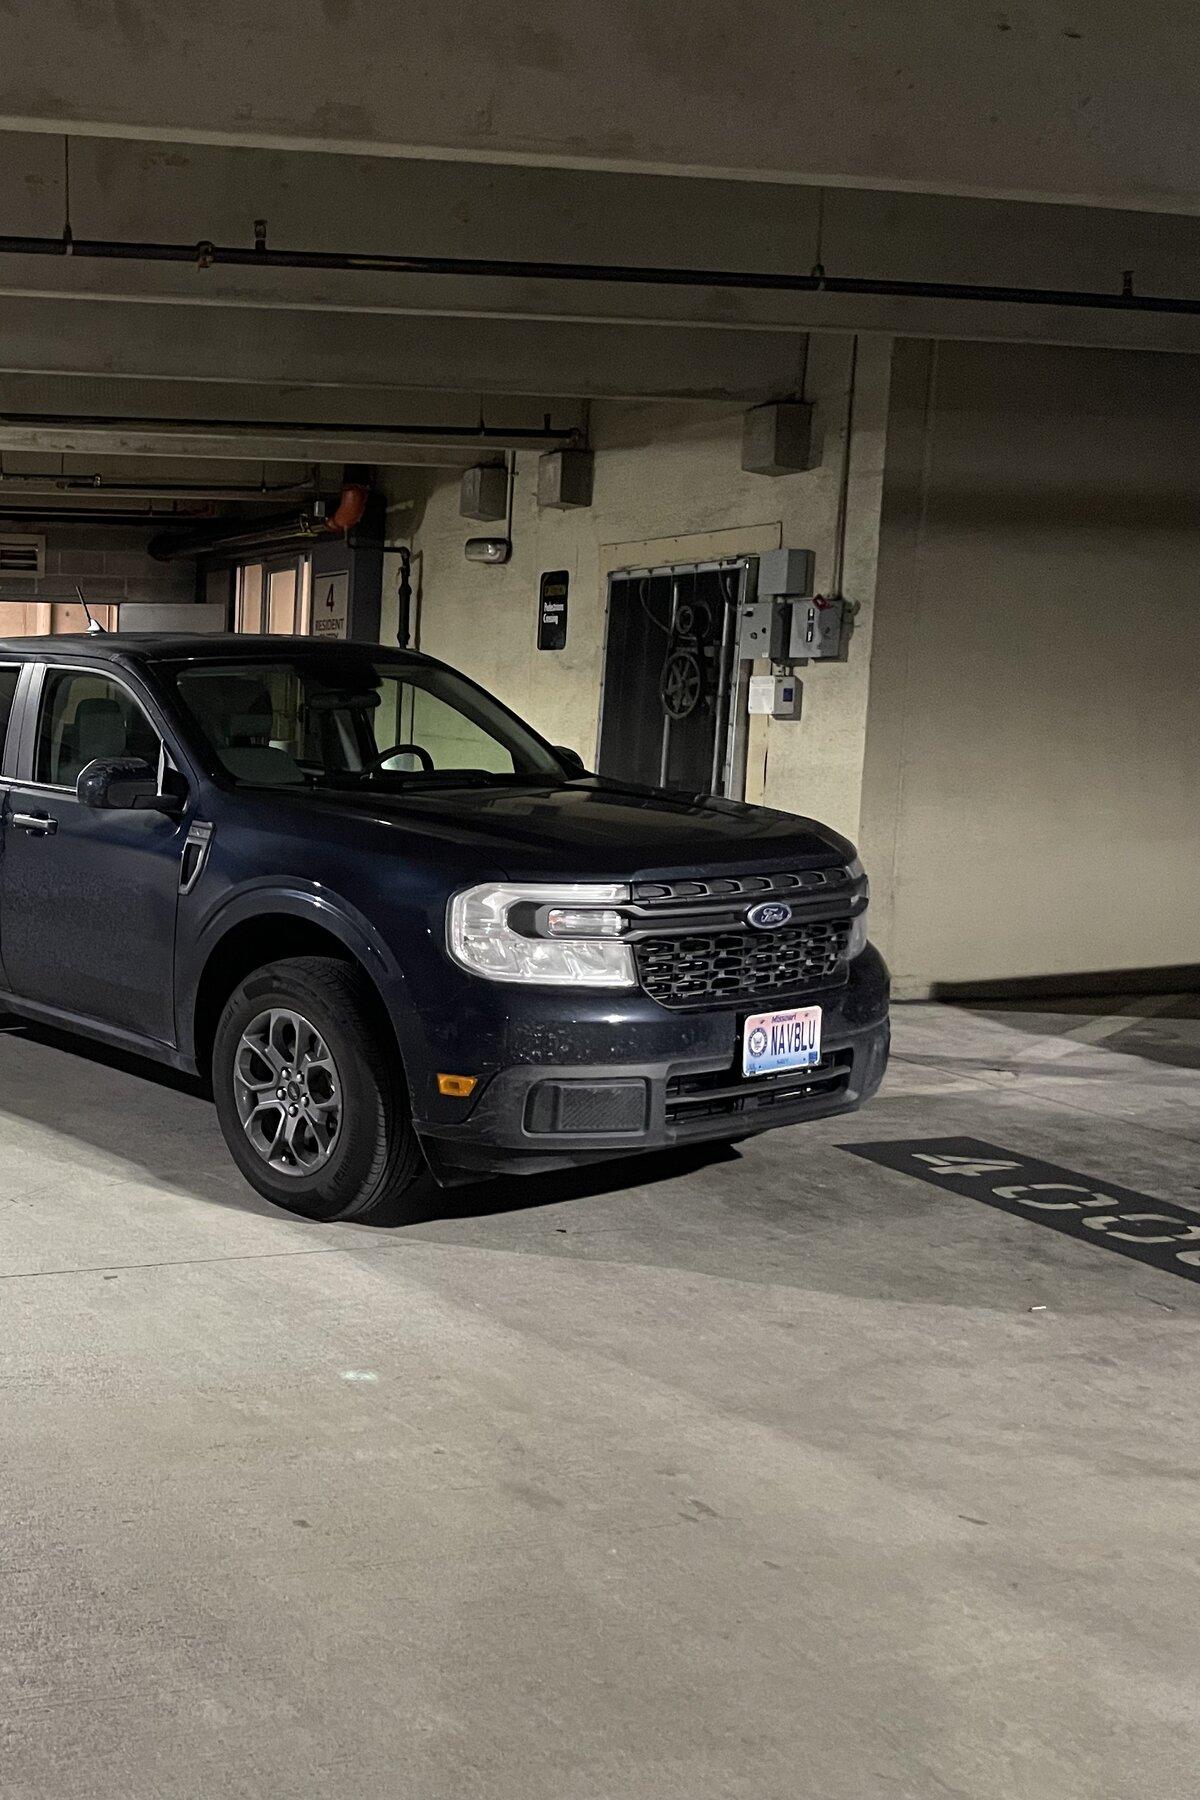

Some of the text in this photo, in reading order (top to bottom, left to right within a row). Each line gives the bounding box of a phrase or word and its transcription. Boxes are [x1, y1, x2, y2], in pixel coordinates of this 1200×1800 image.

[326, 583, 335, 613] 4
[315, 617, 345, 632] RESIDENT
[761, 907, 785, 923] Ford
